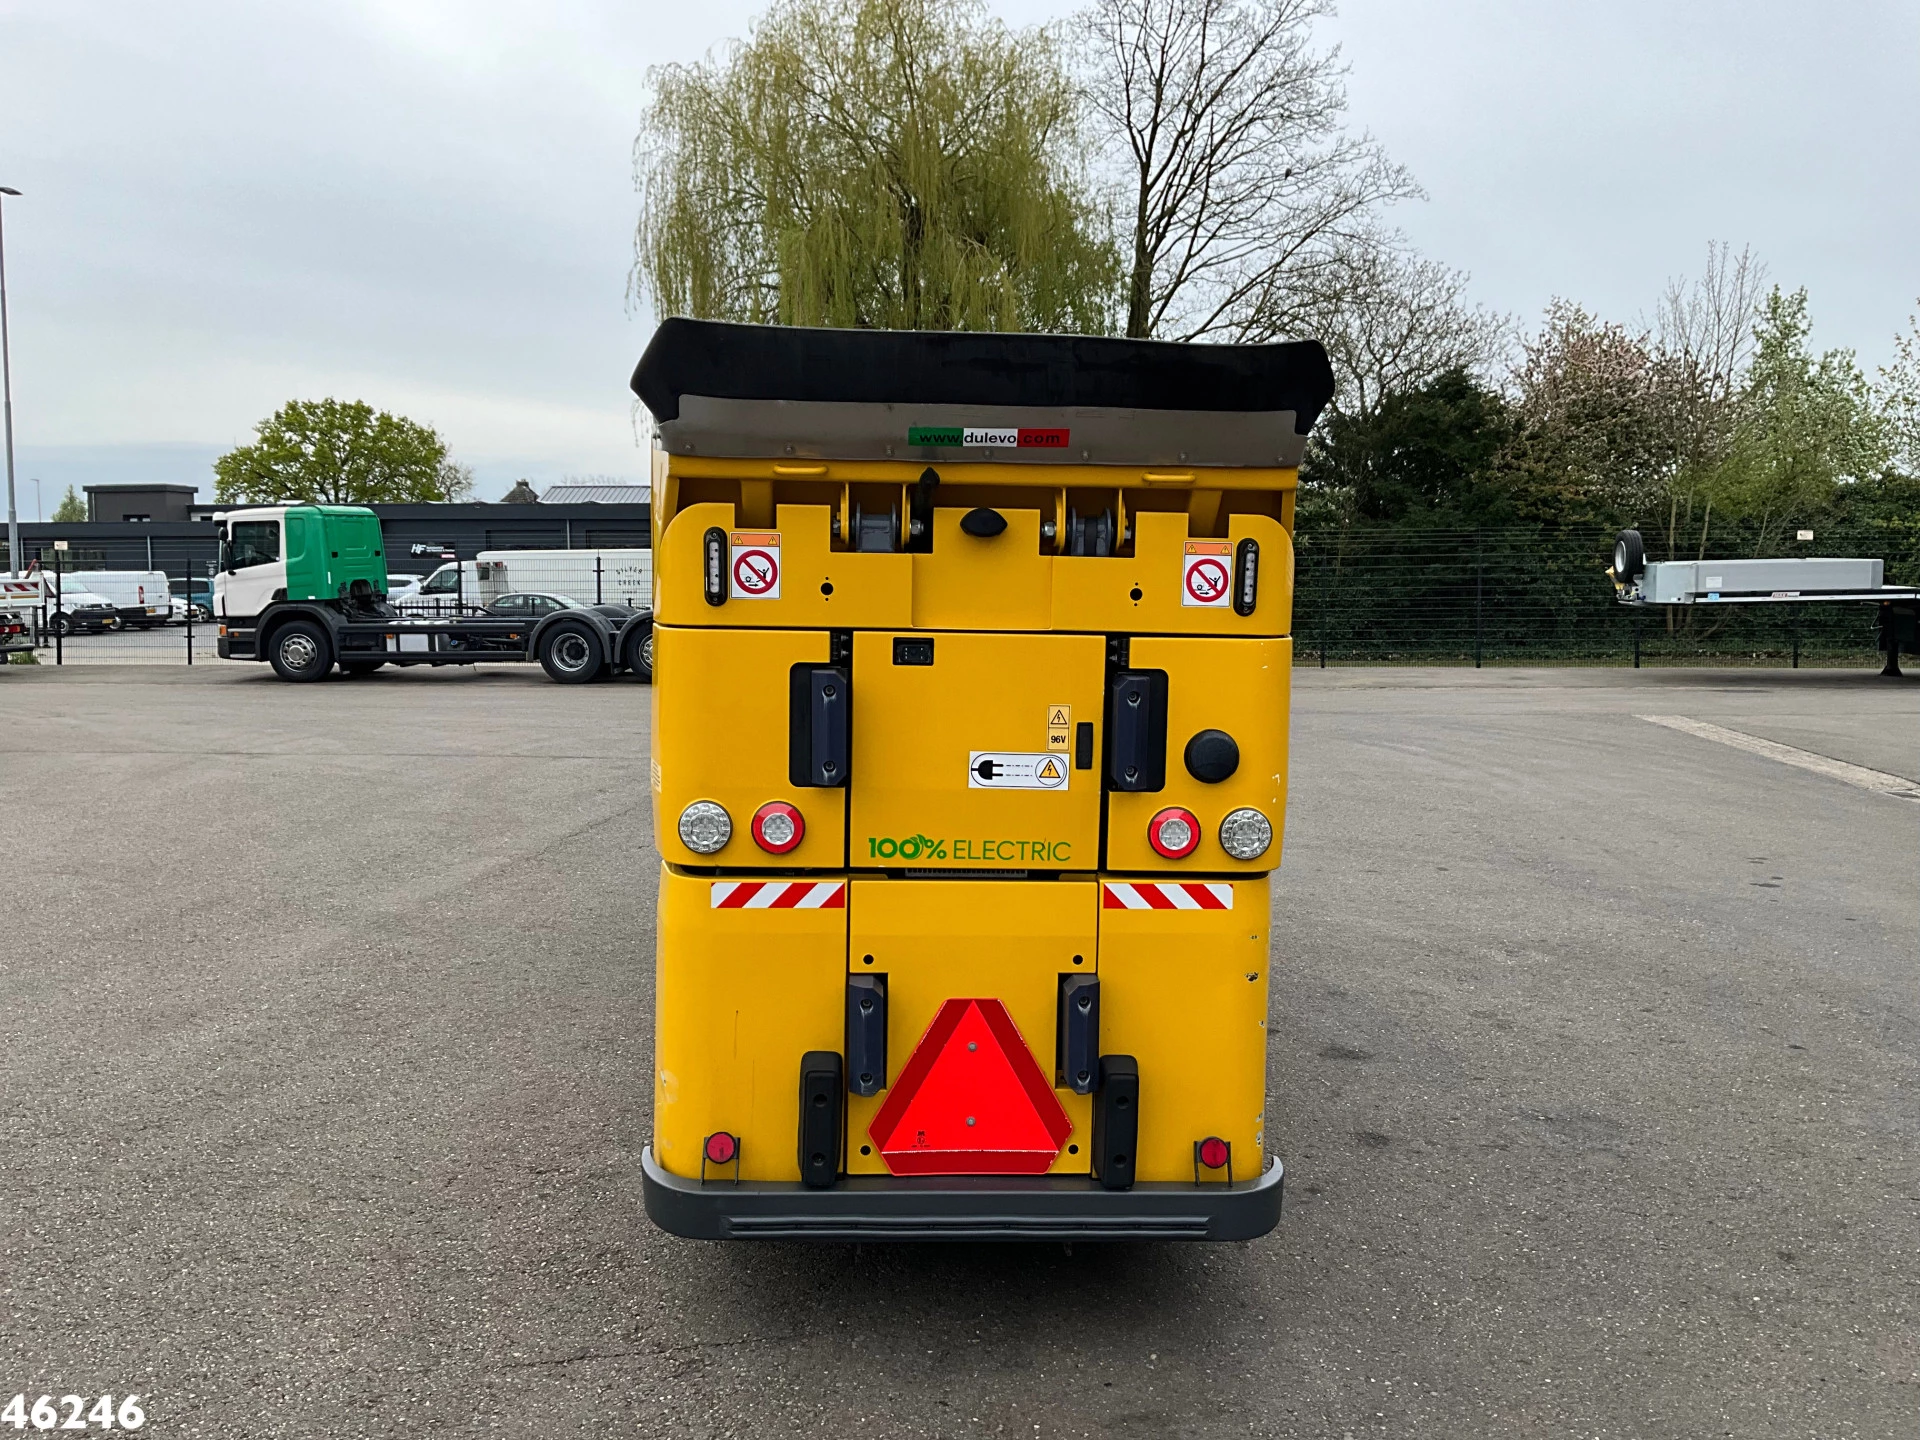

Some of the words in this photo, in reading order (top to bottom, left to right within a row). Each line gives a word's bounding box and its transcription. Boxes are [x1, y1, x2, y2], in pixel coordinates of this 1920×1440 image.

[919, 431, 1061, 445] www.dulevo.com
[411, 543, 426, 554] HF
[1050, 735, 1066, 744] 96V
[868, 834, 947, 860] 100%
[953, 839, 1071, 862] ELECTRIC
